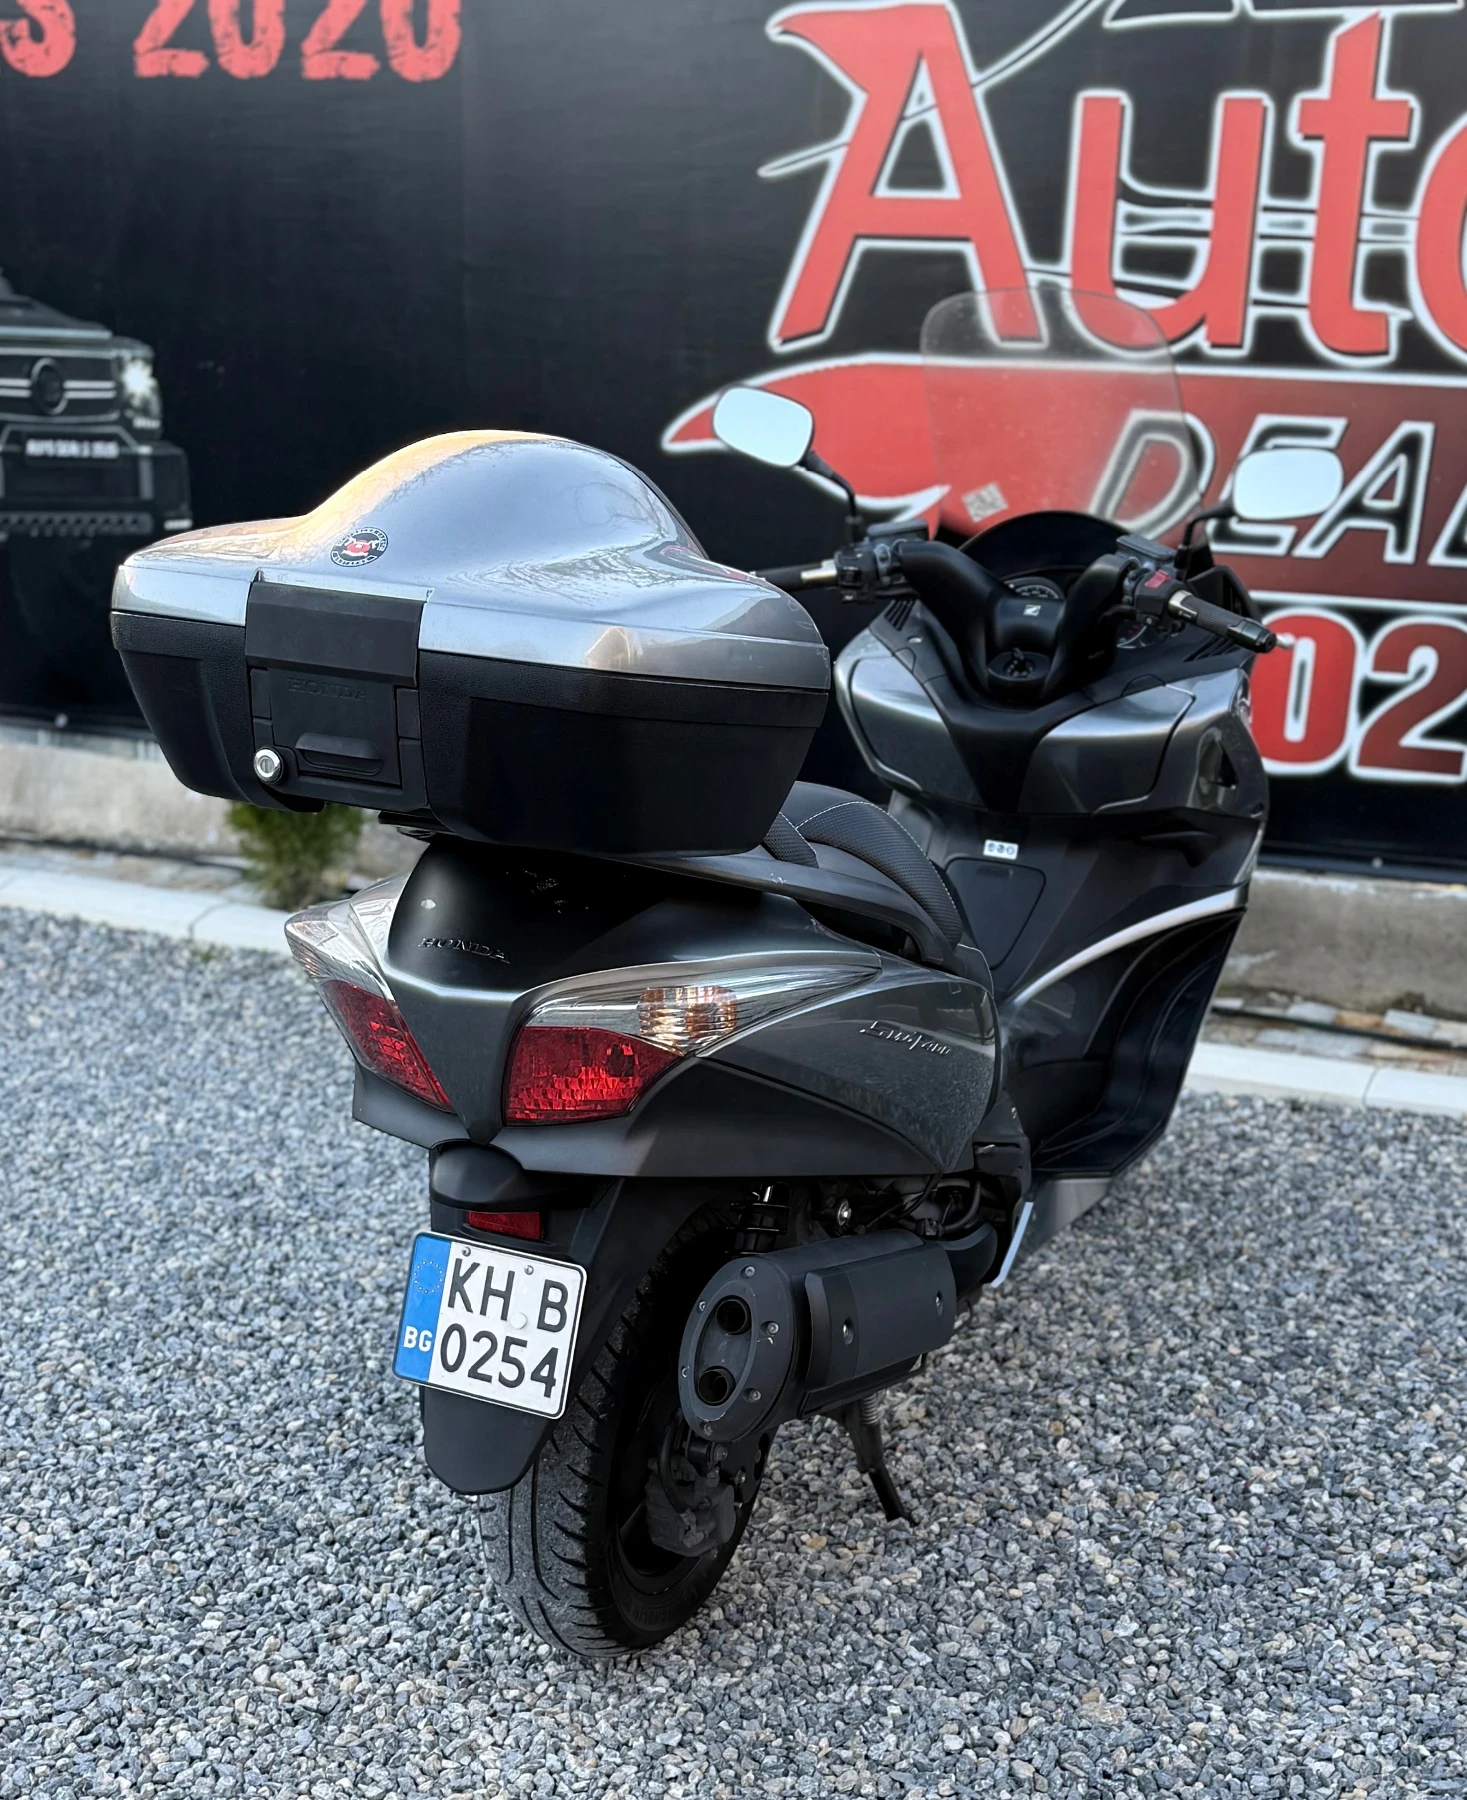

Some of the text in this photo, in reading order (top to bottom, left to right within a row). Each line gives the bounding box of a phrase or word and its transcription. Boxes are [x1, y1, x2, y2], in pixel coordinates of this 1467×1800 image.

[417, 937, 511, 965] HONDA
[447, 1258, 569, 1333] KH B
[403, 1325, 433, 1352] BG
[440, 1322, 559, 1399] 0254
